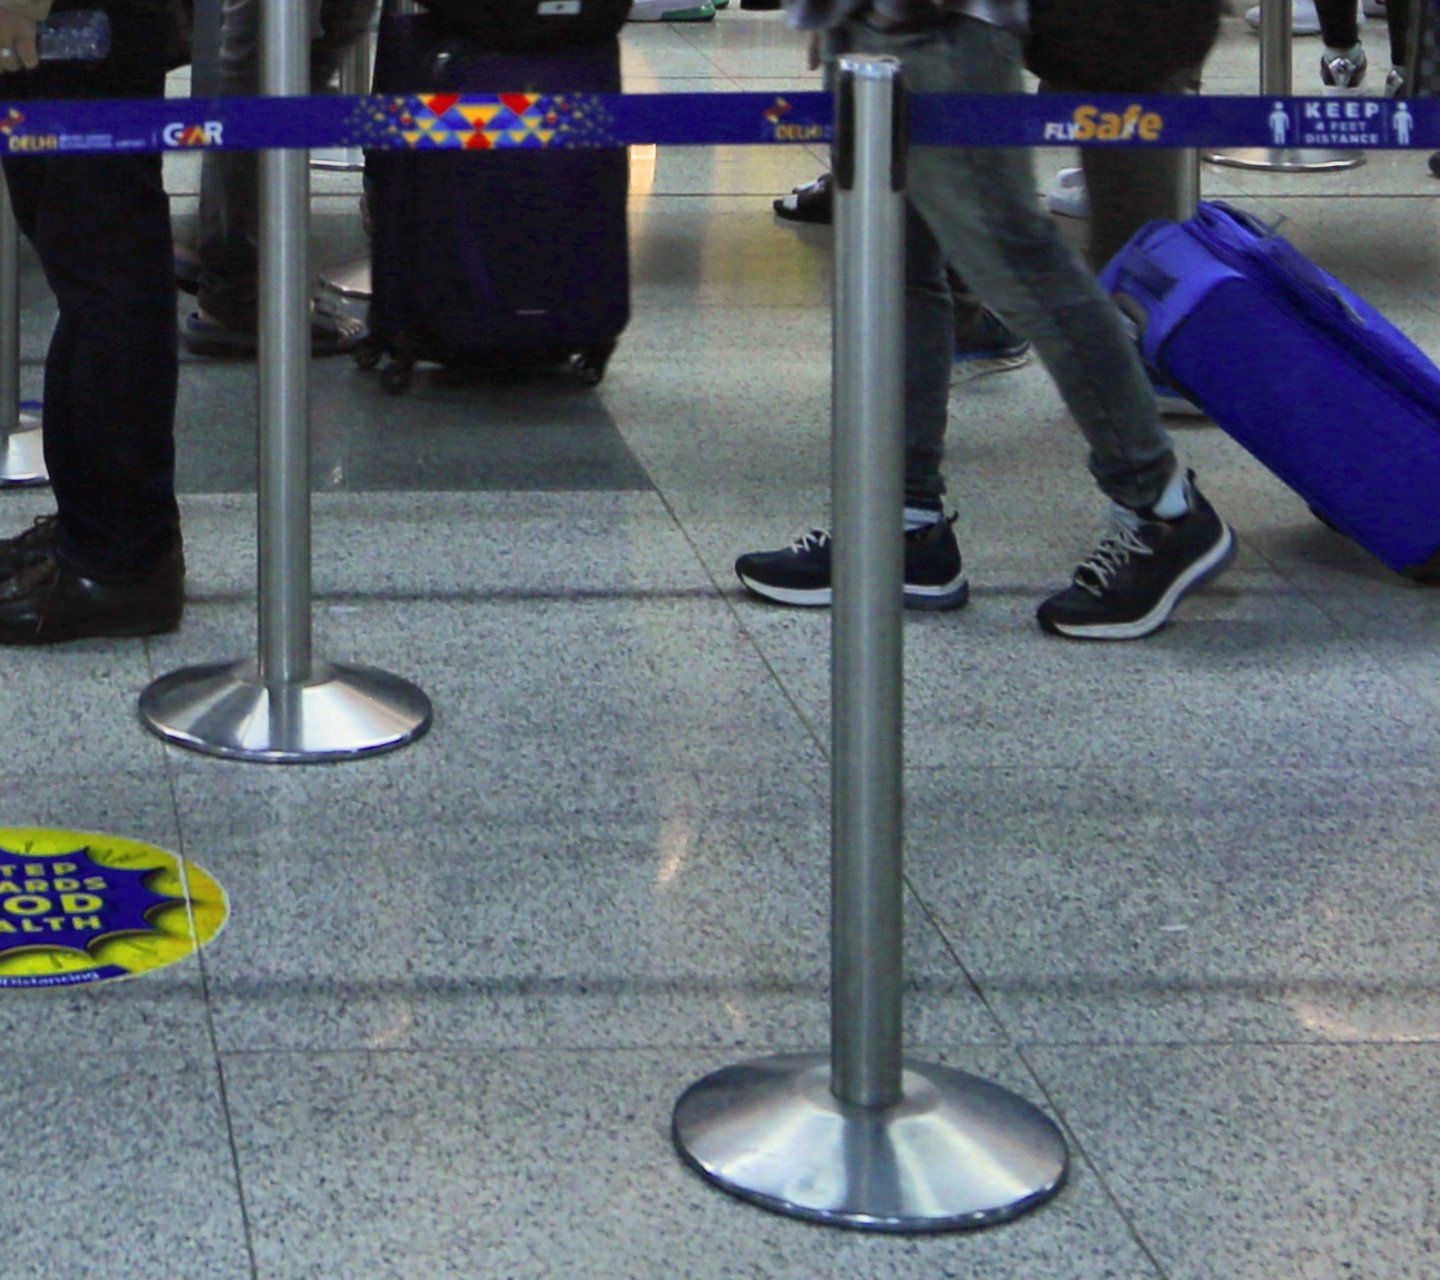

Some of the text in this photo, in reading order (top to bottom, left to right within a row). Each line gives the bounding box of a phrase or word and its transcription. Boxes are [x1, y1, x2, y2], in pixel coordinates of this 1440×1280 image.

[1305, 102, 1379, 118] KEEP
[163, 122, 224, 146] GMR
[1306, 134, 1378, 144] DISTANCE
